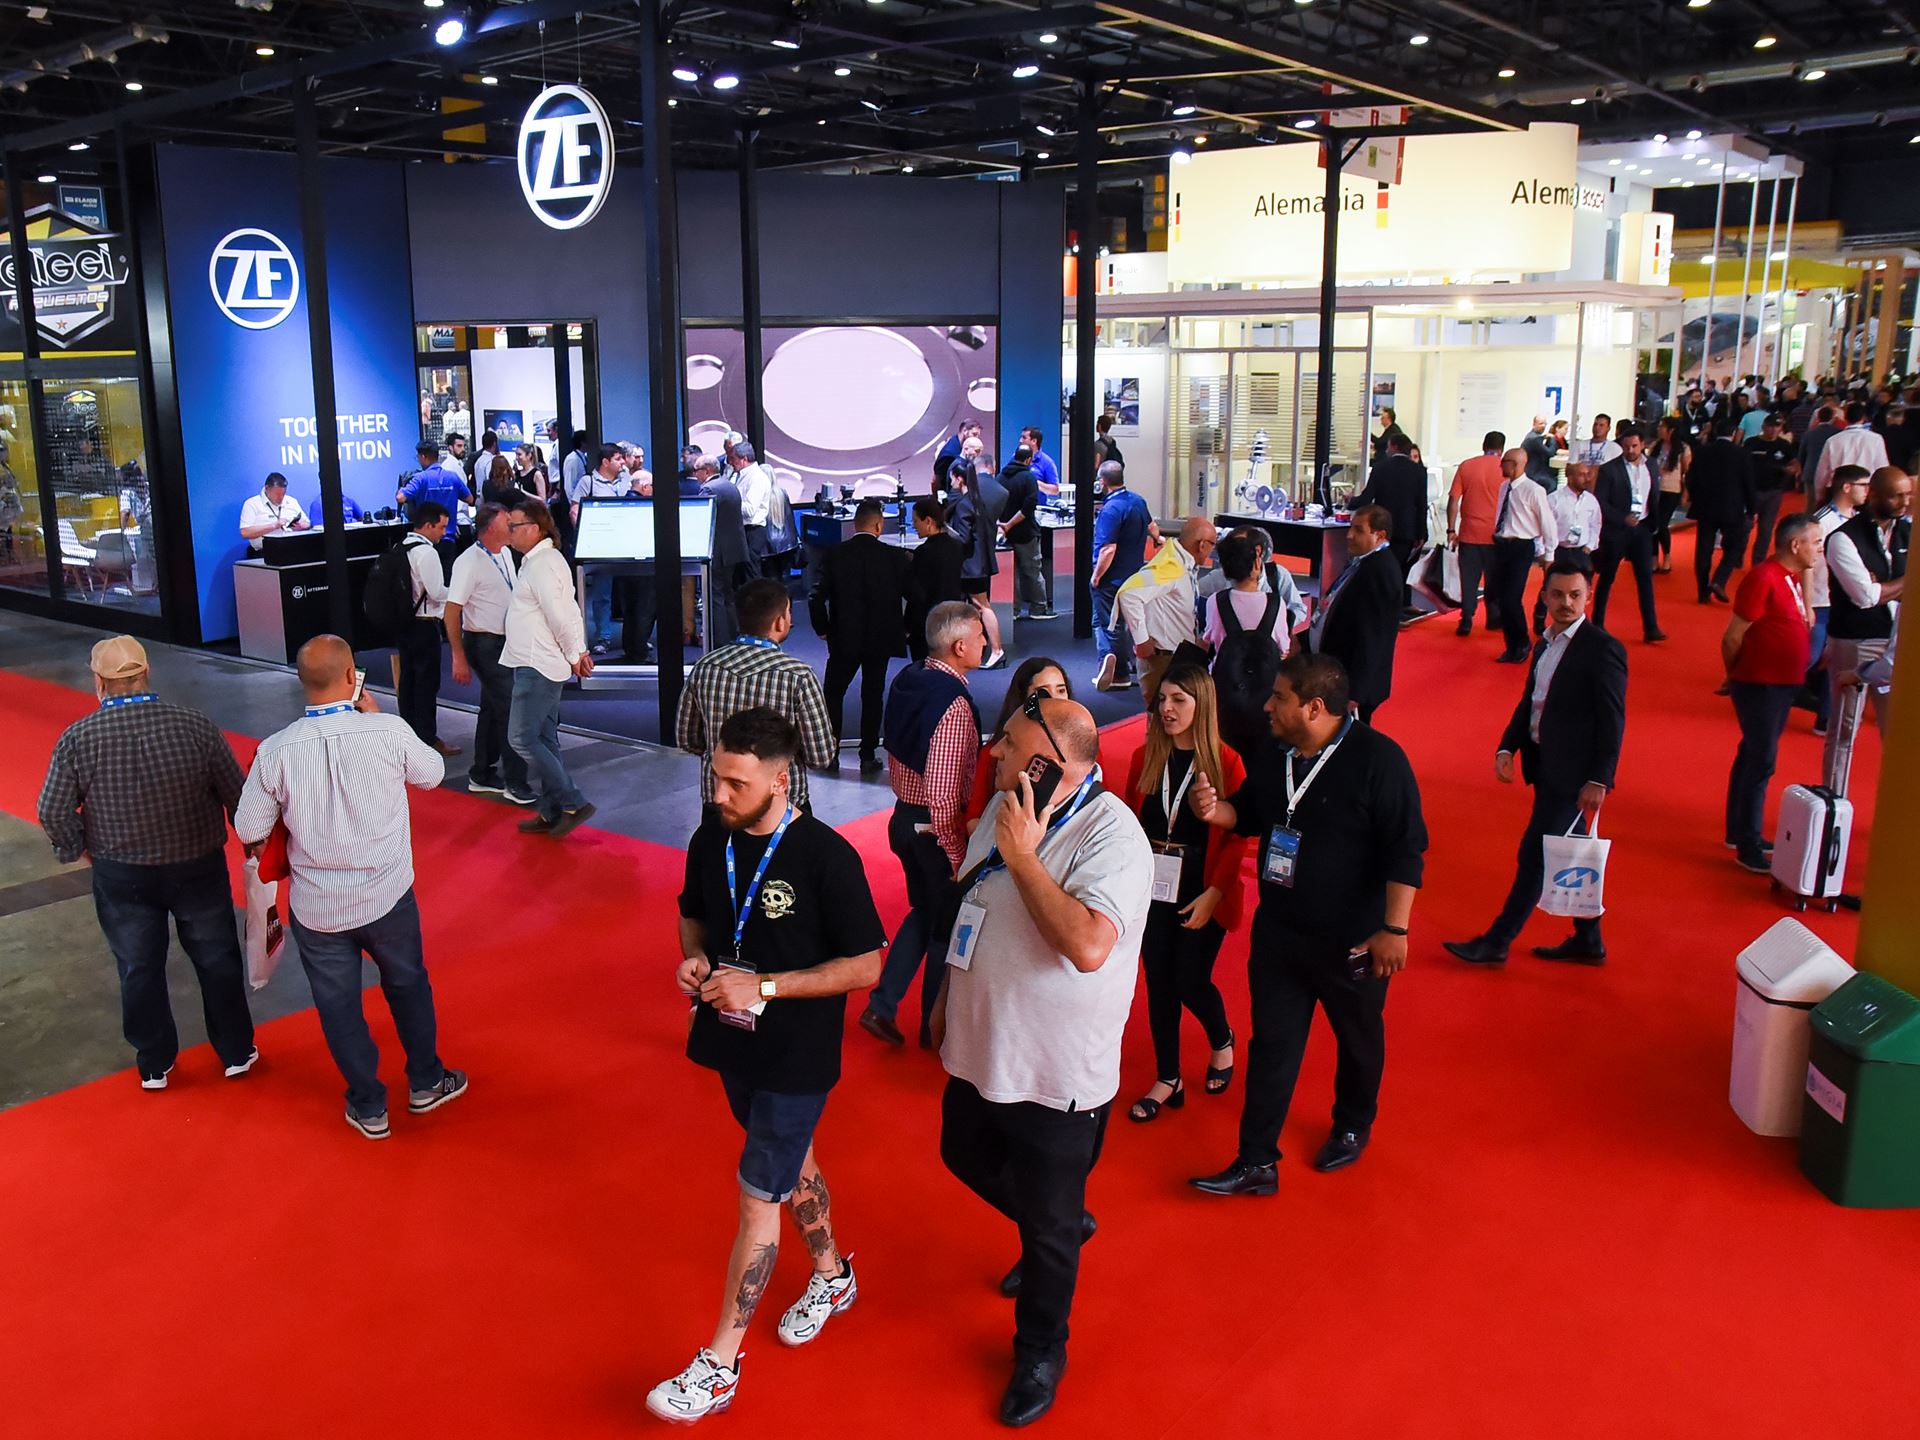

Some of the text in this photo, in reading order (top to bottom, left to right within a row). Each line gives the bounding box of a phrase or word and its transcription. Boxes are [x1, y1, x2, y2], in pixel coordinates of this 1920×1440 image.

[1254, 187, 1365, 217] Alemaia
[8, 291, 110, 312] RPUESTOS
[279, 413, 389, 438] TOTHER
[281, 439, 391, 465] IN MTION
